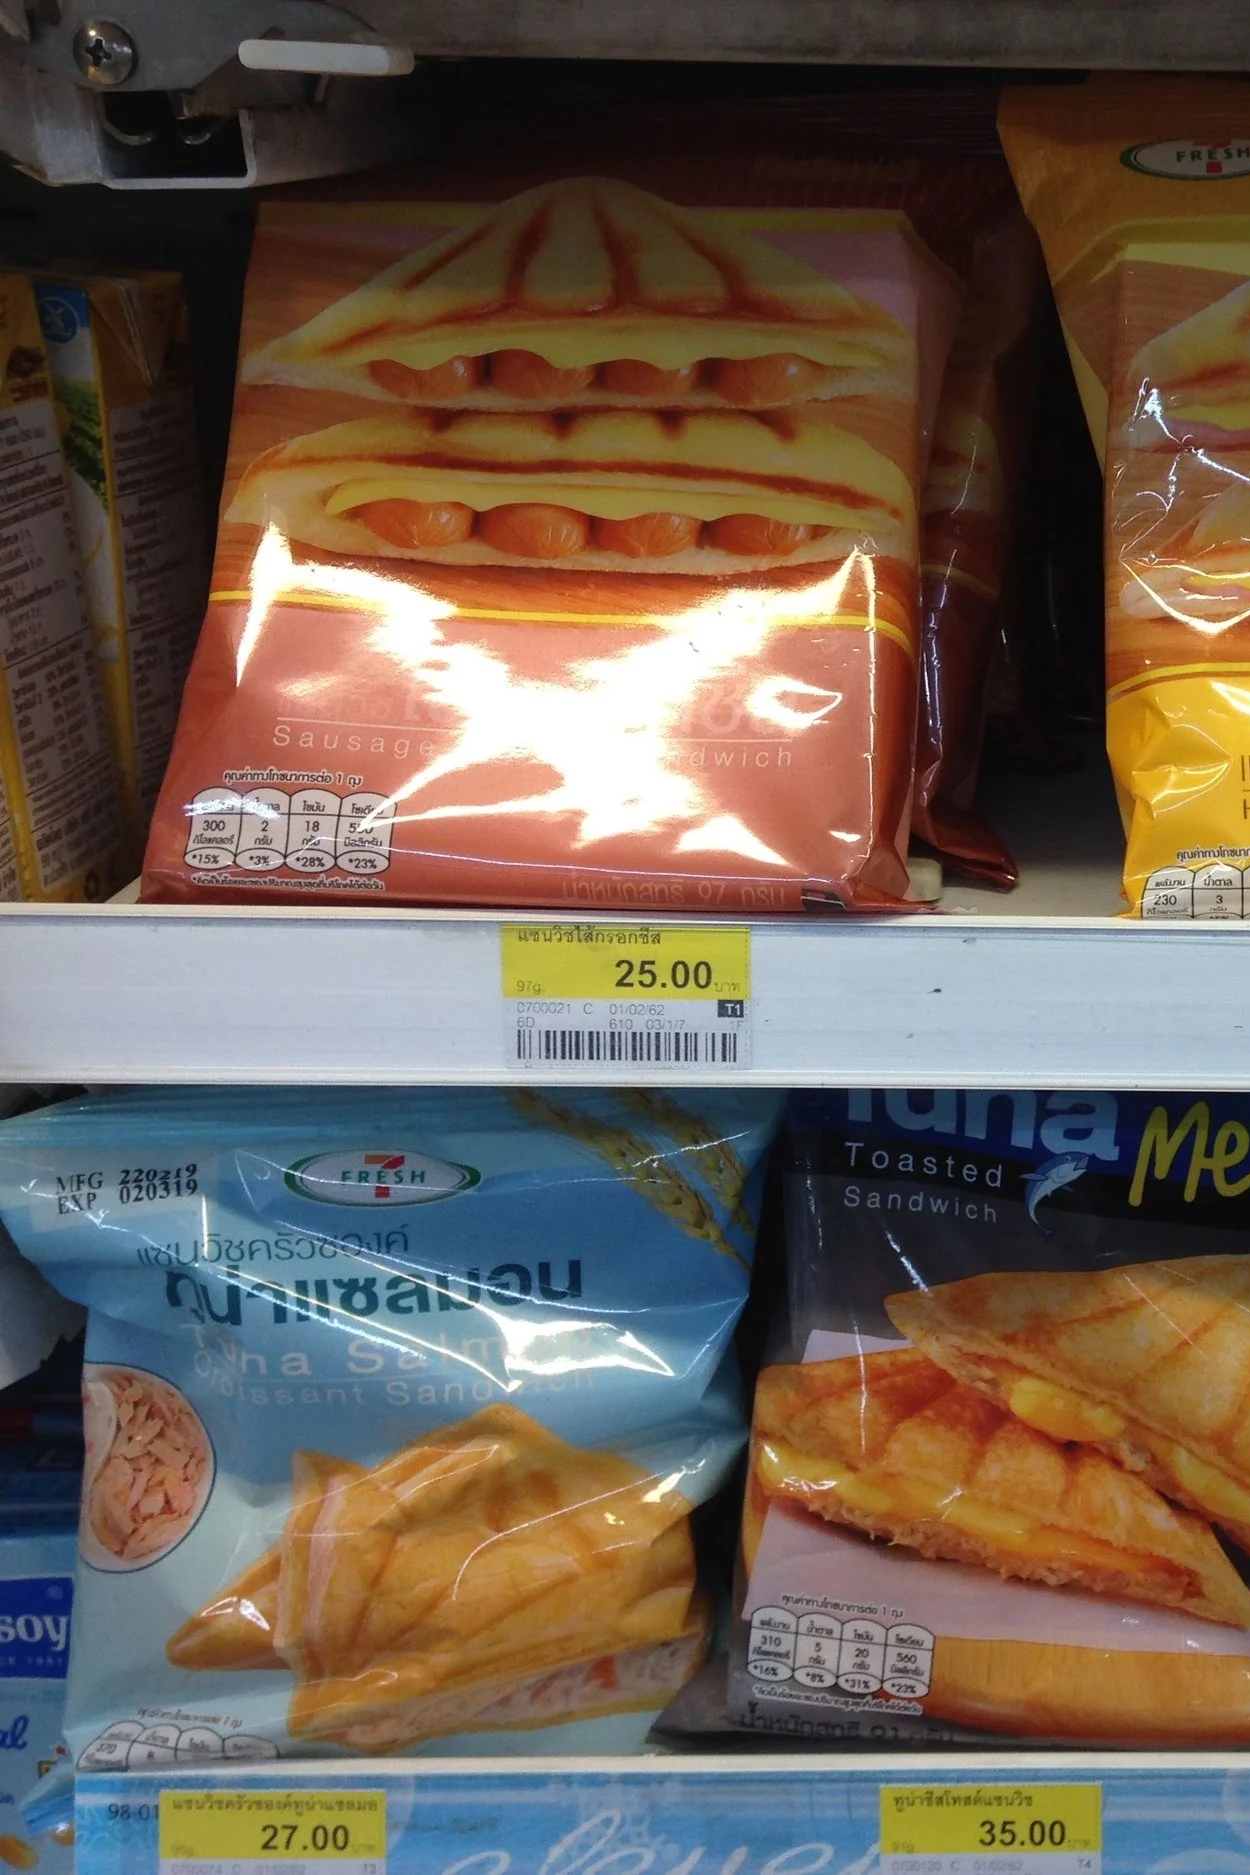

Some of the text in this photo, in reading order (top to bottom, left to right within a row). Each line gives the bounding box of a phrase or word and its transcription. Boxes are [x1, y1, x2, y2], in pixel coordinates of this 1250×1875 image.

[1176, 148, 1250, 163] FRESH
[273, 725, 435, 760] Sausage
[202, 820, 226, 832] 300
[261, 820, 268, 832] 2
[305, 821, 320, 832] 18
[1154, 894, 1177, 906] 230
[1216, 895, 1223, 905] 3
[615, 959, 713, 989] 25.00
[517, 1002, 742, 1015] 0700021 C 01/02/62 T1
[517, 1018, 535, 1028] 6D
[844, 1141, 1004, 1189] Toasted
[56, 1172, 103, 1194] MFG
[341, 1170, 425, 1185] FRESH
[57, 1178, 198, 1214] EXP 020319
[843, 1185, 998, 1225] Sandwich
[761, 1635, 781, 1646] 310
[815, 1642, 822, 1653] 5
[854, 1648, 869, 1658] 20
[897, 1653, 918, 1664] 560
[261, 1824, 349, 1850] 27.00
[979, 1819, 1066, 1847] 35.00
